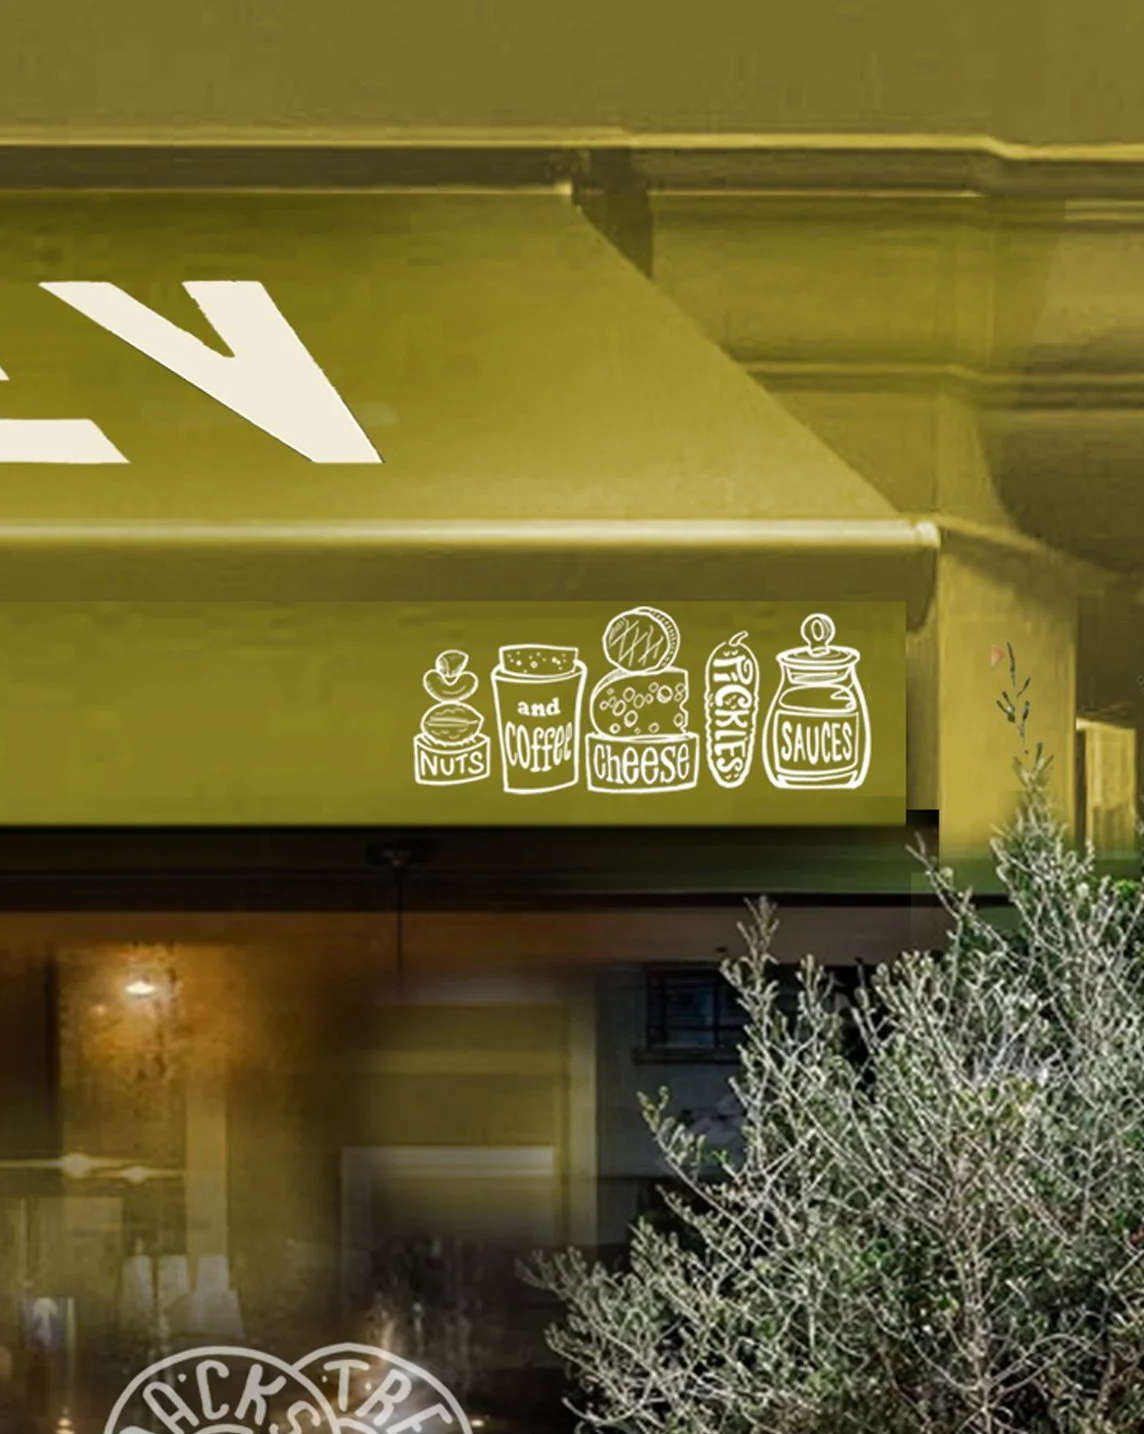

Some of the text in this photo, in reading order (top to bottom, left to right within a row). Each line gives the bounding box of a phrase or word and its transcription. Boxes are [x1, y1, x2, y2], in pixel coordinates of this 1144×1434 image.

[517, 697, 561, 717] and
[781, 719, 855, 766] SAUCES
[420, 750, 485, 777] NUTS
